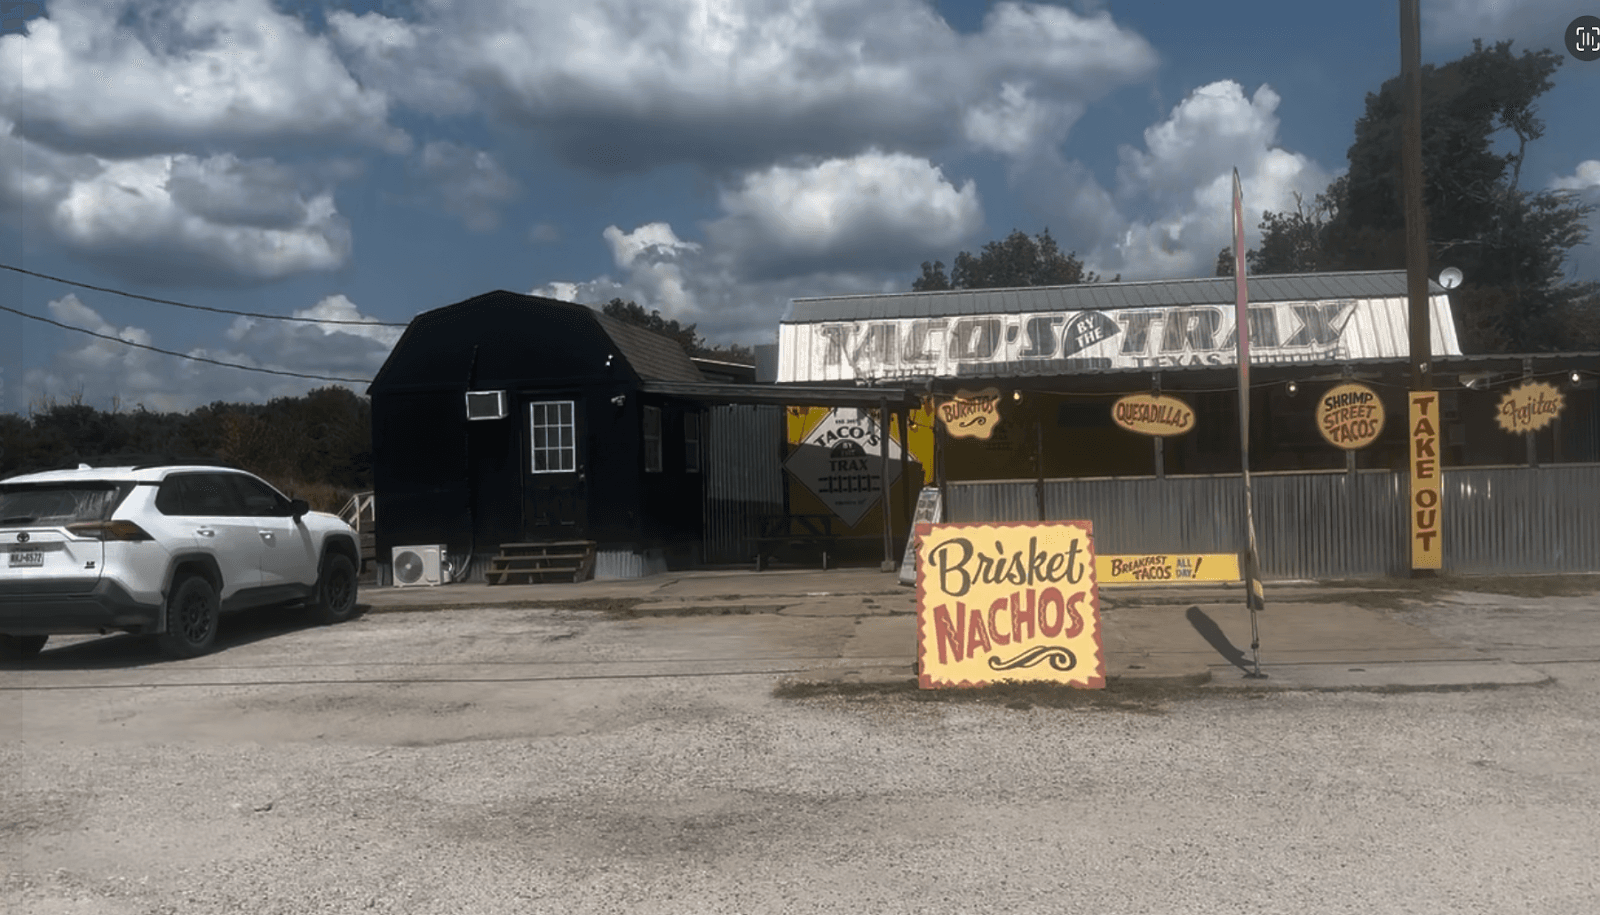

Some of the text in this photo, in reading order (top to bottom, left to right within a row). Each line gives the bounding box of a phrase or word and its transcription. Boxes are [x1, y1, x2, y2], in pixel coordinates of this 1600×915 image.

[1075, 326, 1103, 348] THE
[1077, 316, 1093, 334] BY
[1118, 302, 1357, 356] TRAX
[820, 313, 1064, 365] TACO'S
[942, 396, 995, 422] BURRITOS
[1325, 392, 1373, 411] SHRIMP
[1503, 392, 1558, 427] Fajitas
[1117, 402, 1190, 427] QUESADILLAS
[1323, 404, 1377, 429] STREET
[813, 426, 881, 447] TACO'S
[1329, 419, 1378, 442] TACOS
[829, 459, 868, 471] TRAX
[1412, 395, 1438, 552] TAKE OUT
[928, 536, 1085, 597] Brisket
[1132, 565, 1172, 579] TACOS
[933, 586, 1086, 665] NACHOS
